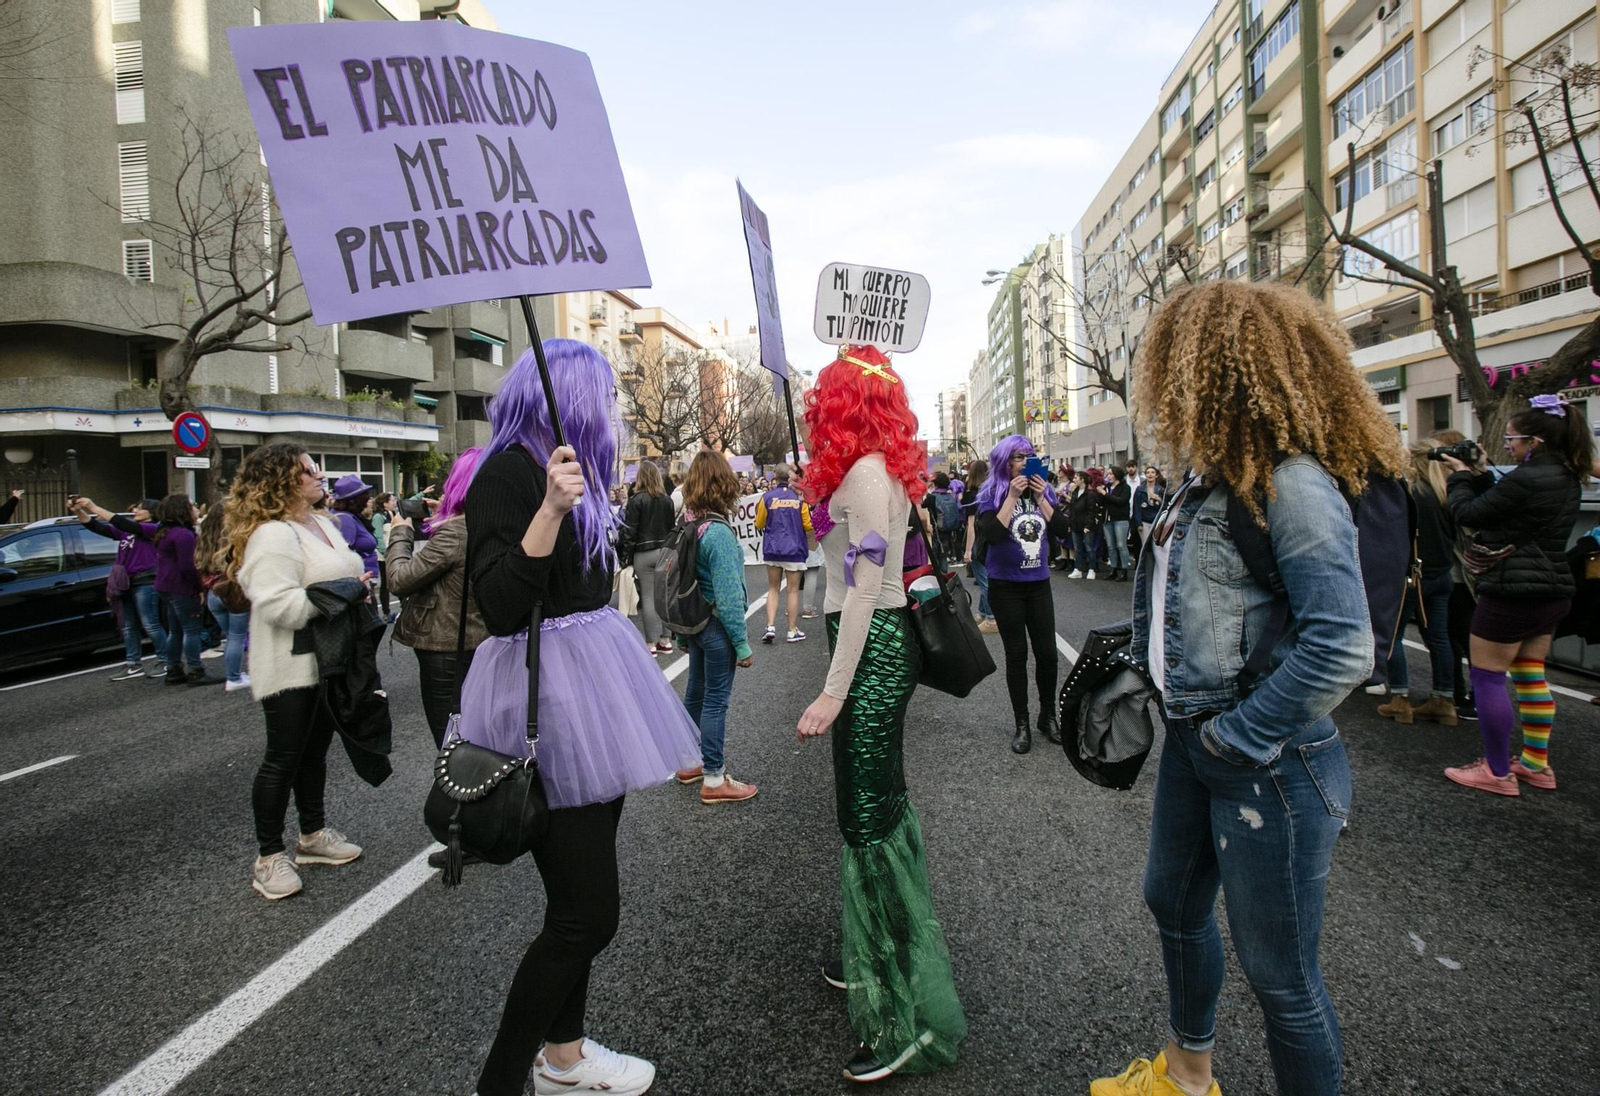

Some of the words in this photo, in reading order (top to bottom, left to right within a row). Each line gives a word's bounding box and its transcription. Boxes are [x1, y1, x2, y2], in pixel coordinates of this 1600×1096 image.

[253, 63, 329, 140] EL
[340, 55, 557, 133] PATRIARCADO
[393, 137, 464, 212] ME
[476, 133, 539, 203] DA
[334, 208, 608, 294] PATRIARCADAS
[833, 267, 849, 290] MI
[862, 270, 911, 298] CUERPO
[843, 291, 858, 314] NO
[860, 294, 908, 320] QUIERE
[826, 315, 845, 338] TU
